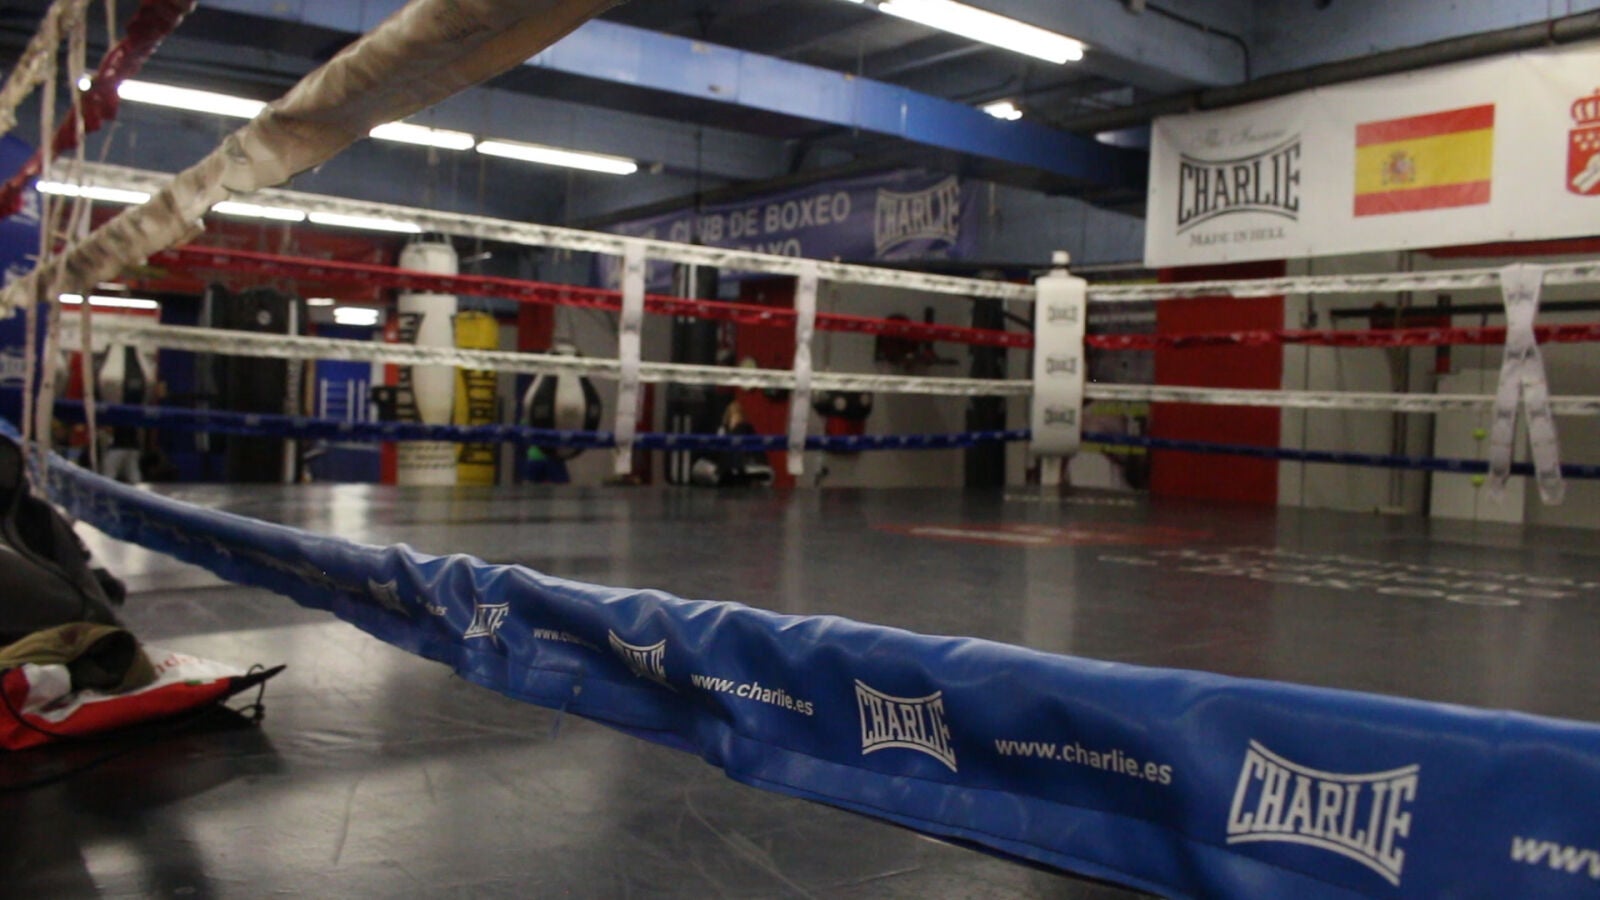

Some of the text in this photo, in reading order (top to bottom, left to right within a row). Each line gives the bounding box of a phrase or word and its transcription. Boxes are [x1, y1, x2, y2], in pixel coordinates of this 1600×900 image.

[730, 208, 759, 239] DE
[764, 192, 851, 233] BOXEO
[874, 180, 961, 251] CHARLIE
[1178, 140, 1301, 226] CHARLIE
[691, 674, 814, 716] www.charlie.es
[855, 684, 957, 768] CHARLIE
[995, 738, 1173, 786] www.charlie.es
[1226, 746, 1419, 880] CHARLIE
